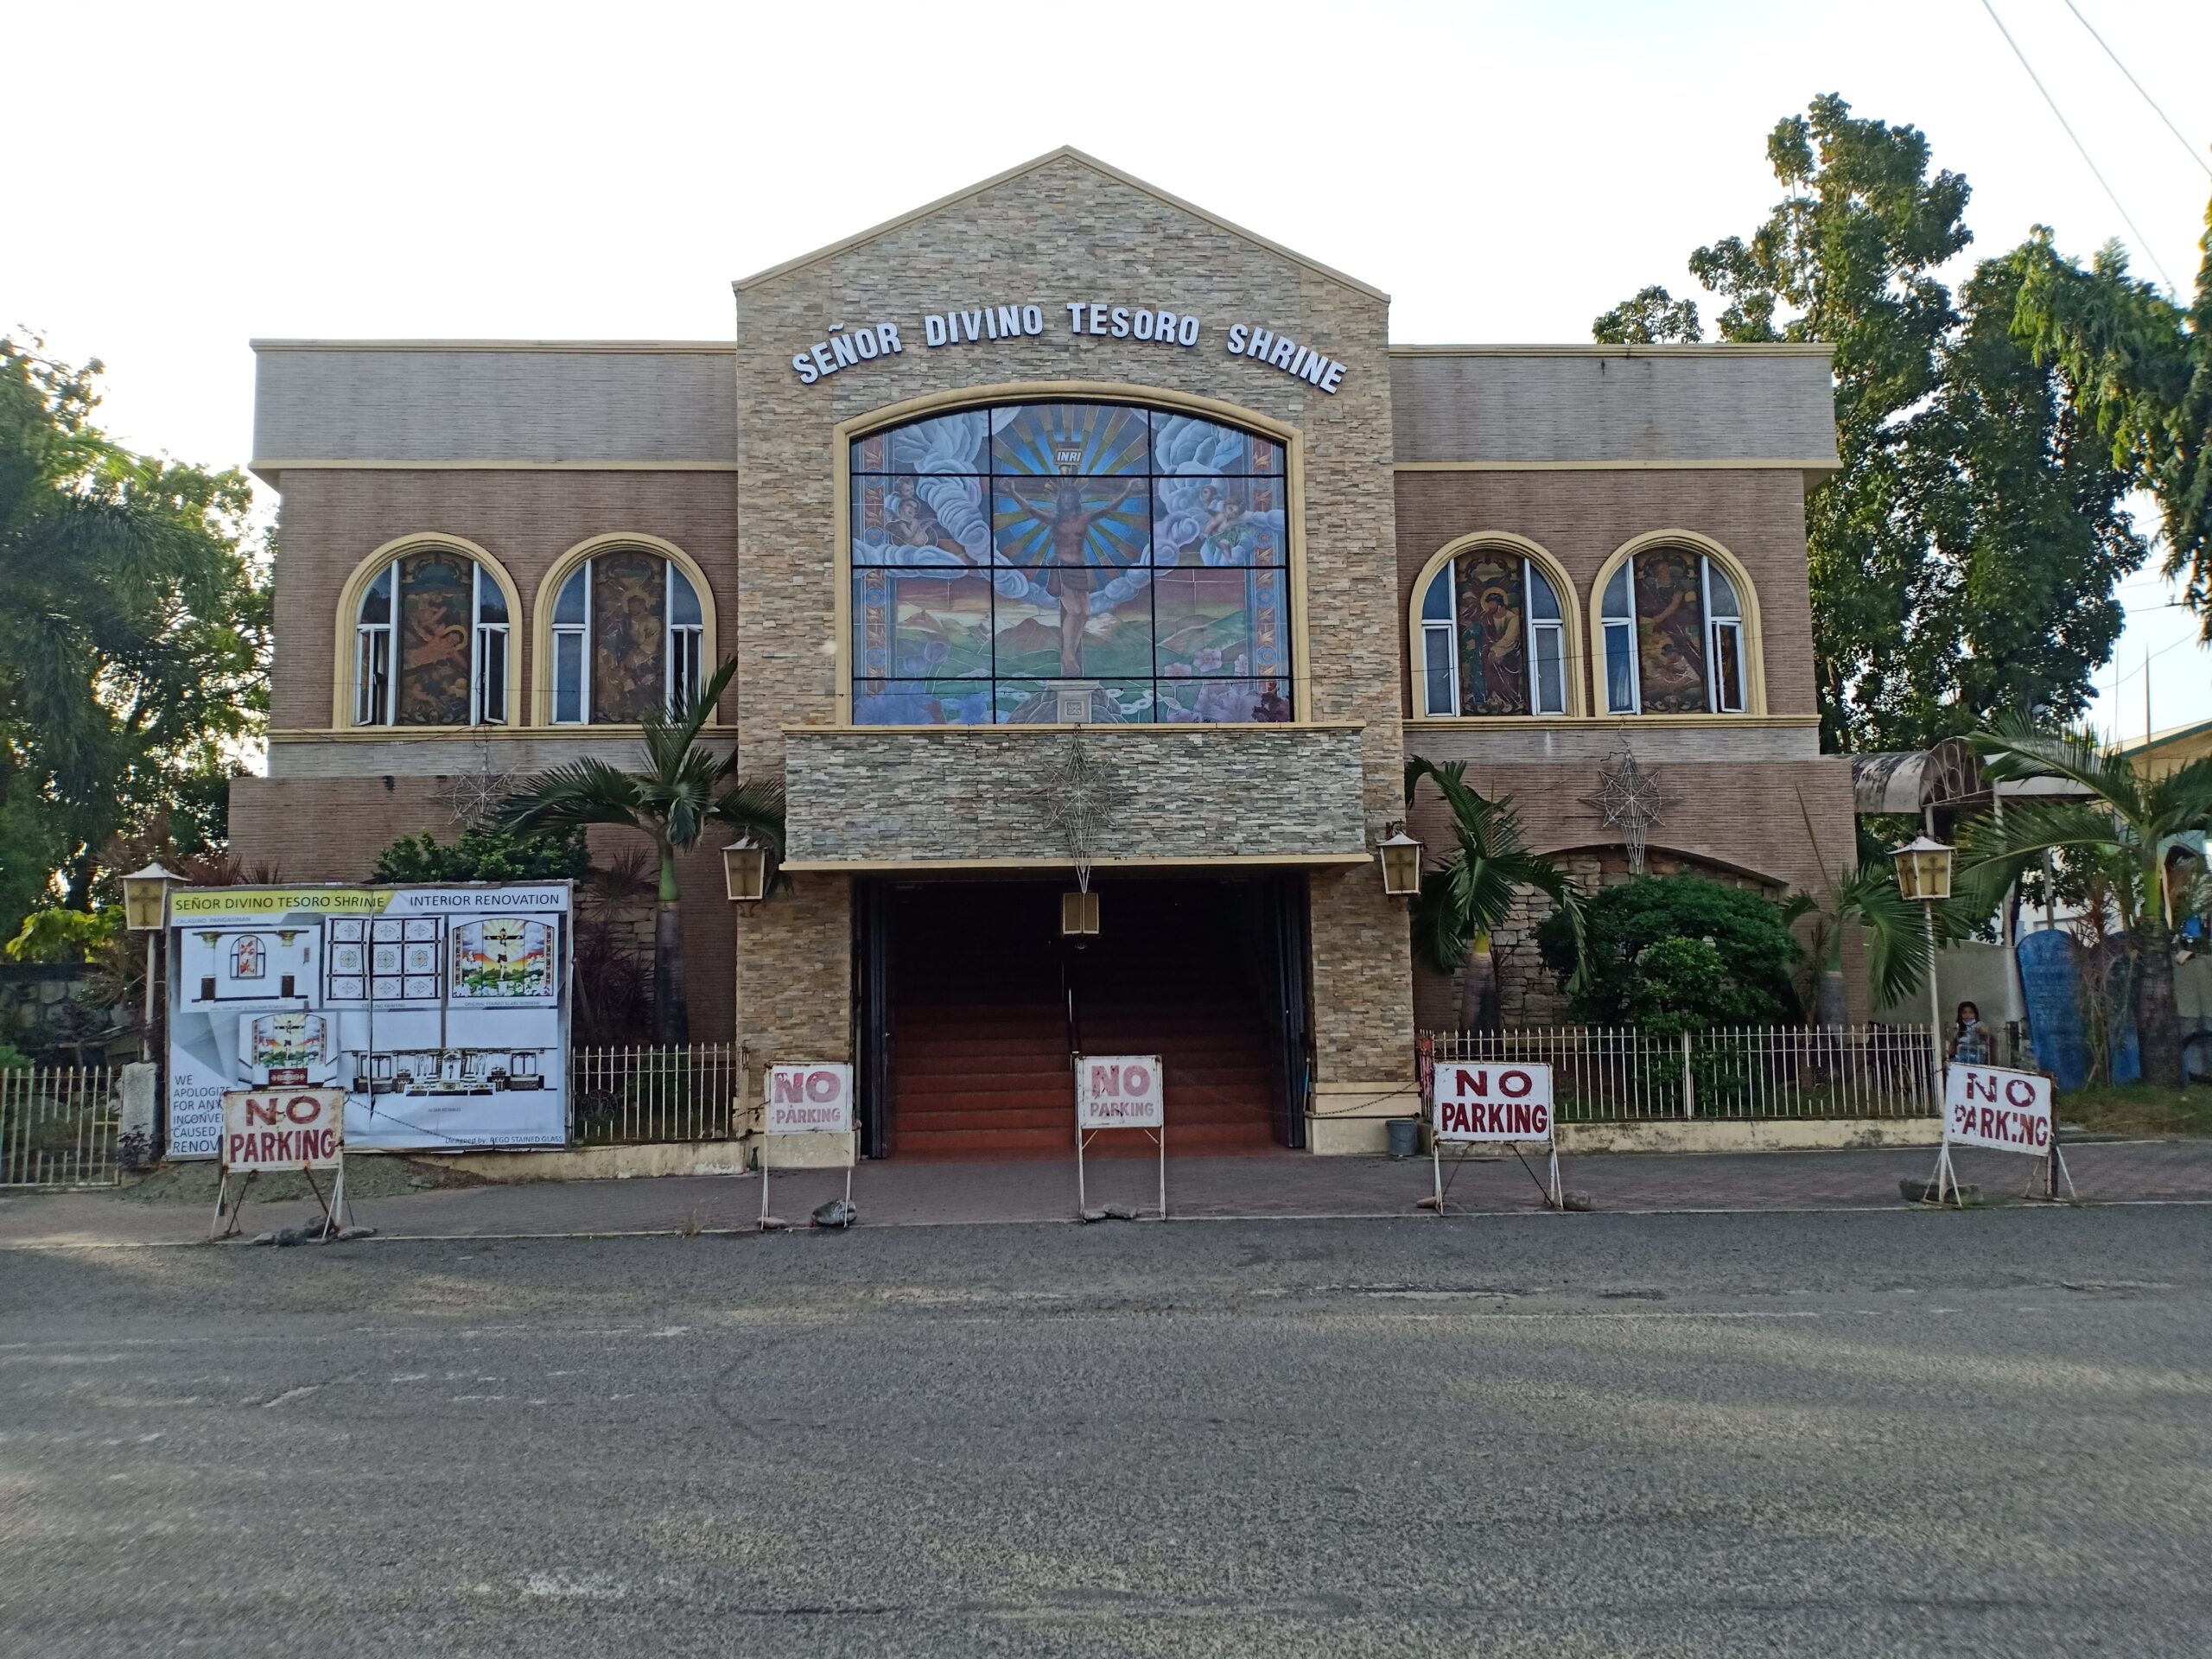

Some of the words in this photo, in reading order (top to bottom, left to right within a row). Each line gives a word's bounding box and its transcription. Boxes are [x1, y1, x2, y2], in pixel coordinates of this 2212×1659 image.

[791, 321, 903, 385] SEÑOR
[924, 304, 1044, 347] DIVINO
[1065, 302, 1201, 346] TESORO
[1226, 323, 1349, 395] SHRINE
[1057, 451, 1082, 462] INRI
[175, 896, 220, 911] SEÑOR
[225, 896, 274, 909] DIVINO
[277, 895, 331, 908] TESORO
[334, 895, 385, 907] SHRINE
[410, 895, 471, 906] INTERIOR
[475, 893, 560, 906] RENOVATION
[175, 1074, 194, 1085] WE
[774, 1071, 842, 1103] NO
[1091, 1065, 1151, 1097] NO
[1456, 1069, 1533, 1098] NO
[1967, 1072, 2036, 1108] NO
[173, 1100, 194, 1111] FOR
[198, 1099, 224, 1110] ANY
[245, 1096, 321, 1127] NO
[776, 1107, 841, 1124] PARKING
[1090, 1102, 1154, 1117] PARKING
[173, 1113, 224, 1124] INCONVE
[1441, 1102, 1548, 1134] PARKING
[1951, 1103, 2049, 1147] PARKING
[173, 1126, 216, 1138] CAUSED
[230, 1128, 337, 1163] PARKING
